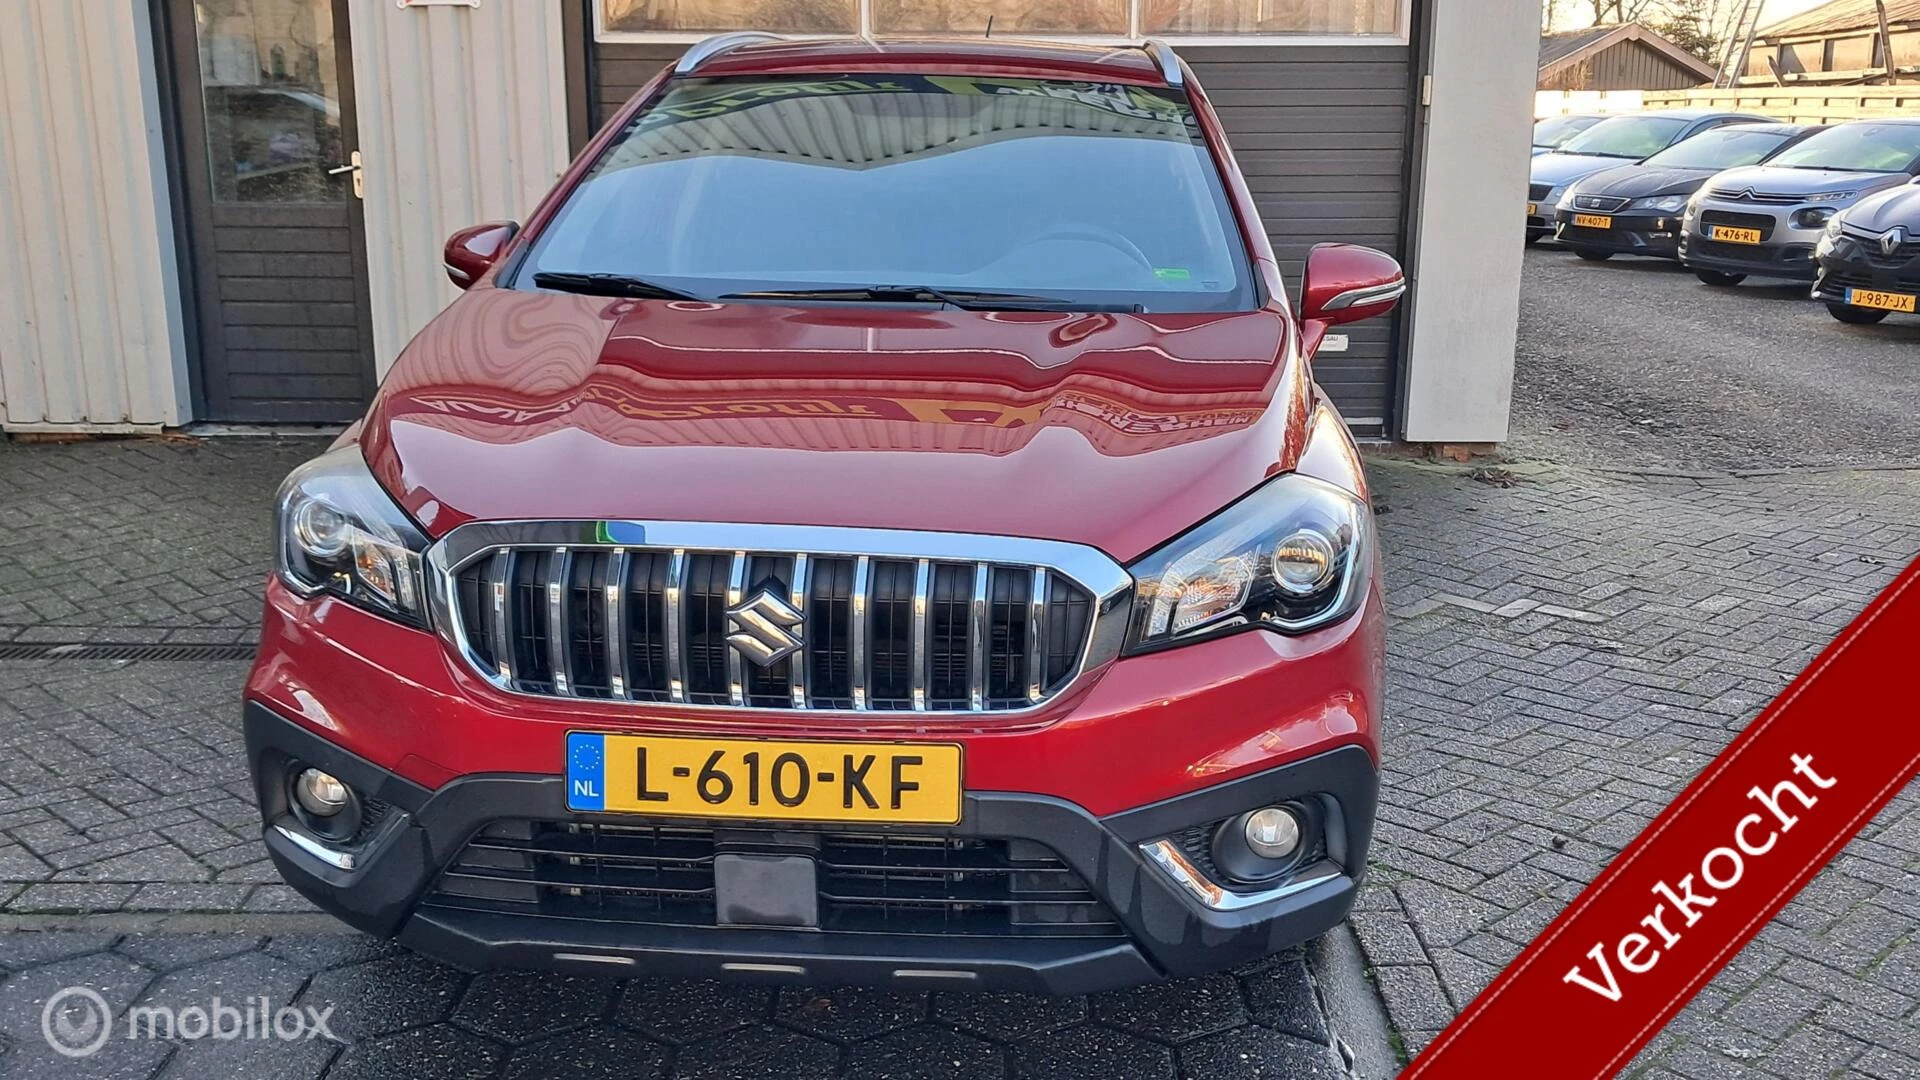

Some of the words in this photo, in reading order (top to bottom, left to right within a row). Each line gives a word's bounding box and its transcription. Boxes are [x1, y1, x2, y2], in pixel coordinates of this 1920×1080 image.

[1575, 214, 1609, 226] NV-407-T
[1714, 227, 1756, 242] K-476-RL
[1855, 291, 1910, 309] J-987-JX
[636, 746, 924, 810] L-610-KF
[574, 779, 600, 797] NL
